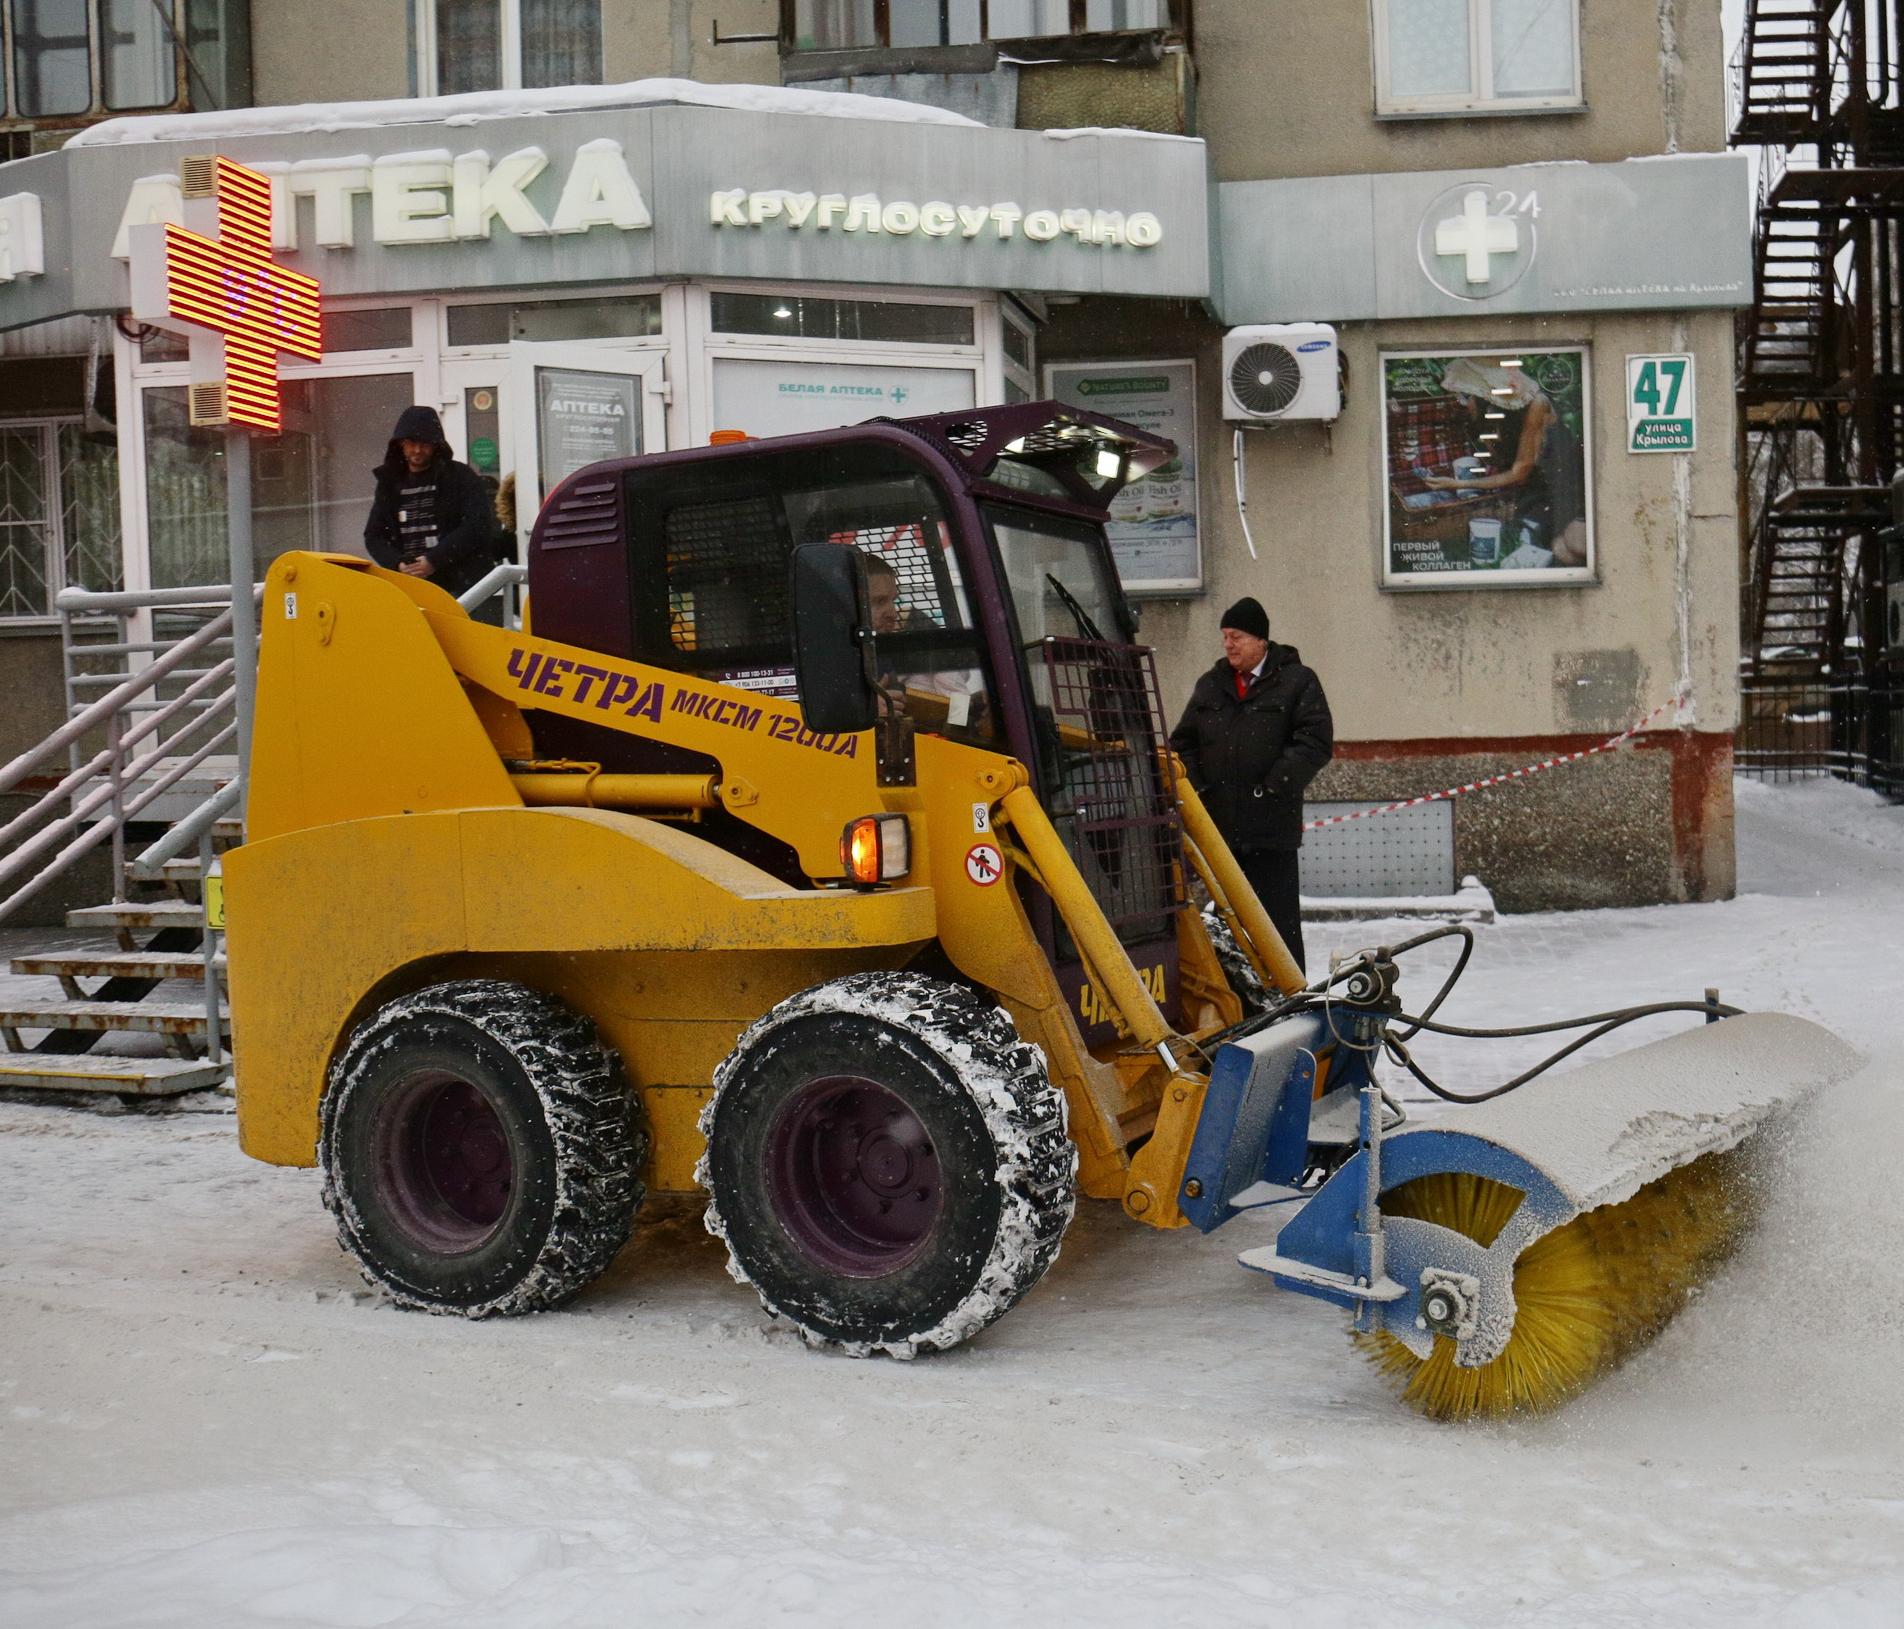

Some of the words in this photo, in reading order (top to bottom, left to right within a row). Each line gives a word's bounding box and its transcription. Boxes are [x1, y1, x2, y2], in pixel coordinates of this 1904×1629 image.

[710, 187, 1163, 249] КРУГЛОСУТОЧНО
[778, 383, 825, 394] БЕЛАЯ
[829, 385, 883, 396] АПТЕКА
[1633, 361, 1686, 416] 47
[550, 399, 625, 416] АПТЕКА
[1645, 423, 1682, 434] улица
[1636, 434, 1688, 447] Крылова
[1393, 540, 1440, 552] ПЕРВЫЙ
[1412, 561, 1471, 571] КОЛЛАГЕН
[507, 648, 665, 723] ЧЕТРА
[670, 688, 763, 731] МКСМ
